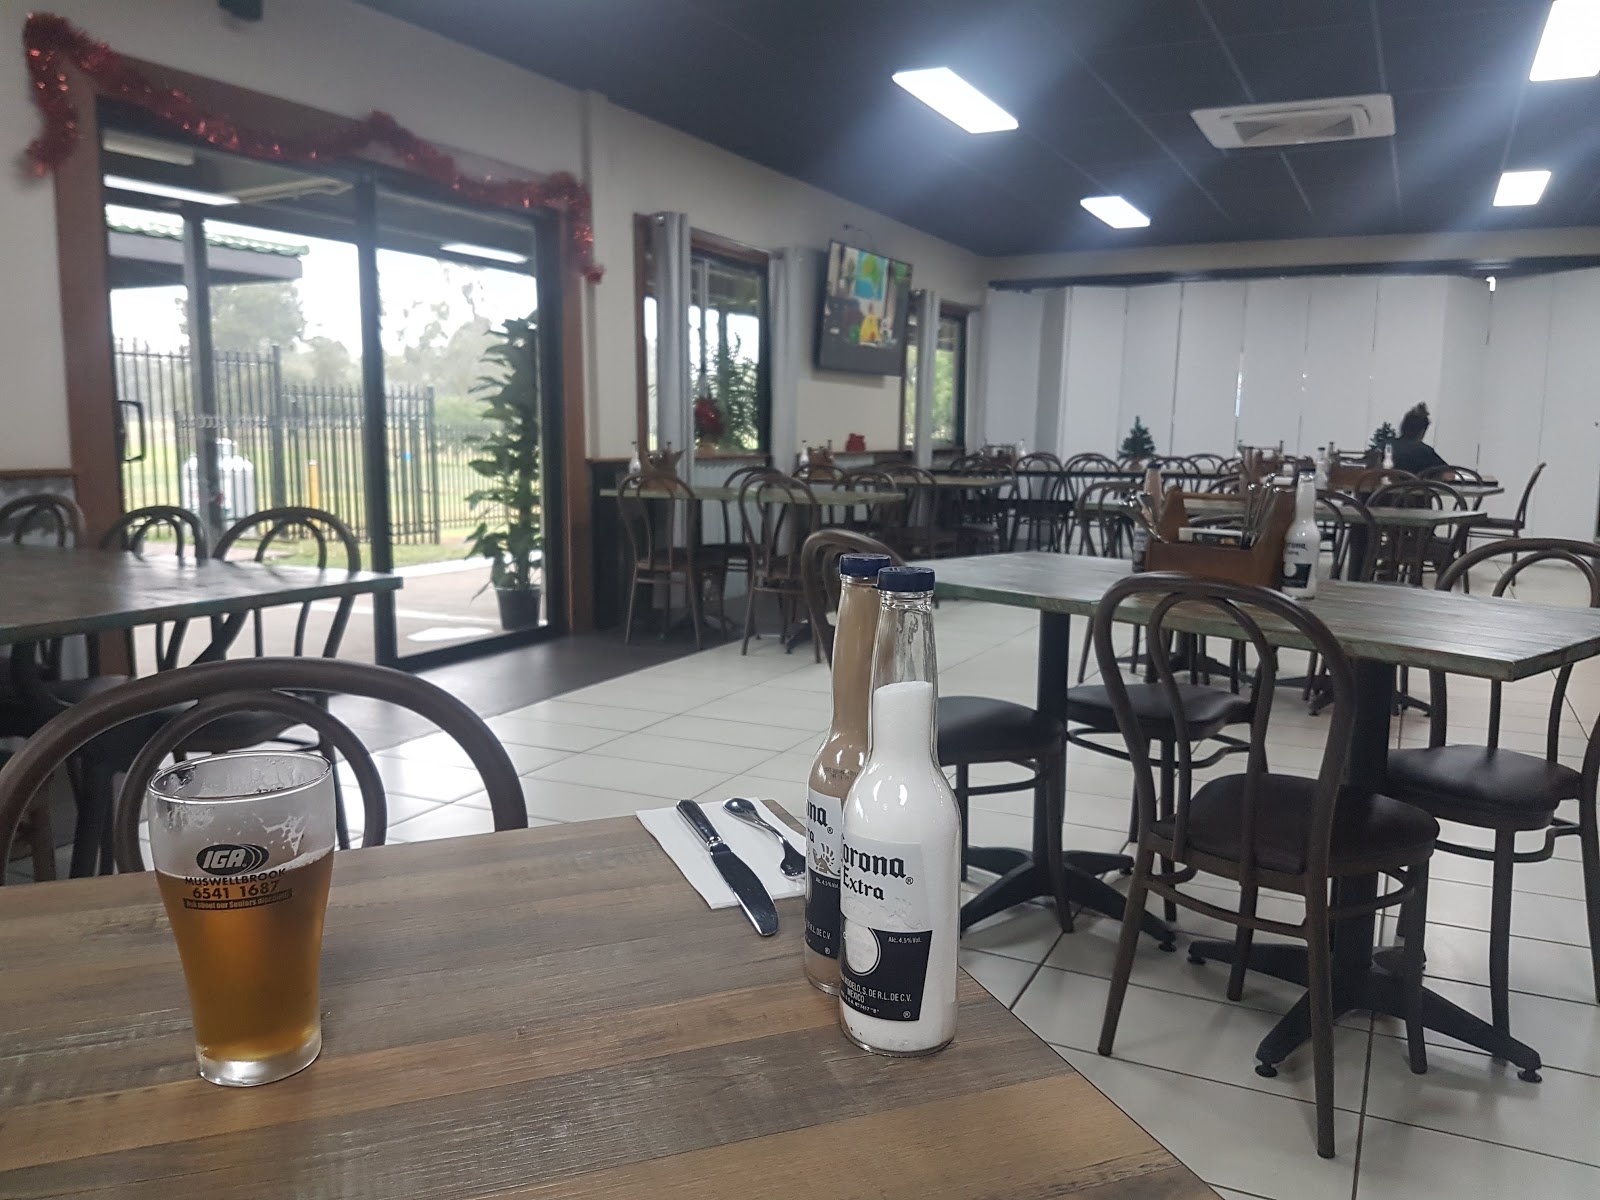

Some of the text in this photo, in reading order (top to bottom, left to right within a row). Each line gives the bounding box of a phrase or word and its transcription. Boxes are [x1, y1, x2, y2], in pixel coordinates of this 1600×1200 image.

[202, 848, 247, 869] IGA
[841, 842, 906, 879] orona
[185, 868, 286, 886] MUSWELLBROOK
[843, 864, 884, 901] Extra
[193, 880, 278, 900] 6541 1687
[198, 901, 216, 909] about
[216, 901, 229, 909] our
[229, 899, 257, 909] Seniors
[868, 988, 877, 999] DE
[877, 990, 889, 1001] R.L.
[890, 993, 900, 1002] DE
[900, 993, 912, 1002] C.V.
